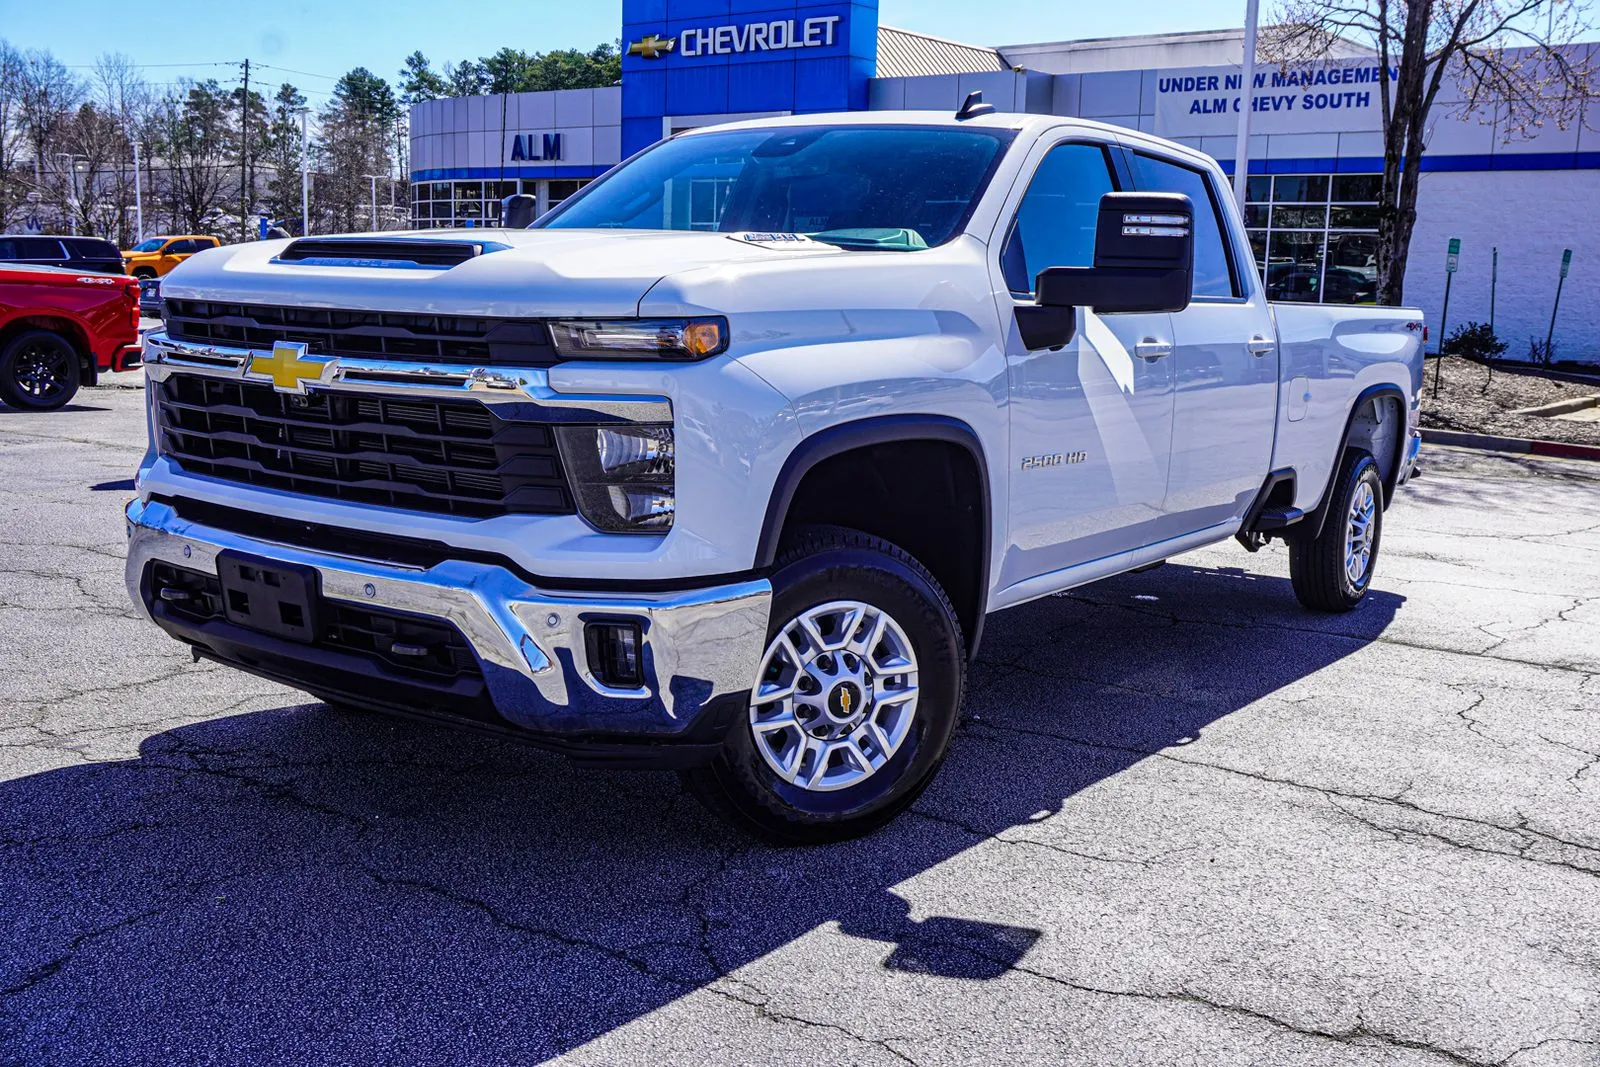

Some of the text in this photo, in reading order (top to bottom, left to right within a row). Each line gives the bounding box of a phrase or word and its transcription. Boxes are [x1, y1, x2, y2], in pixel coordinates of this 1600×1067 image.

[680, 15, 840, 57] CHEVROLET
[1158, 75, 1220, 93] UNDER
[1271, 65, 1399, 89] MANAGEMEN
[1189, 98, 1228, 115] ALM
[1302, 91, 1371, 110] SOUTH
[511, 133, 564, 161] ALM
[1021, 450, 1088, 472] 2500 HD
